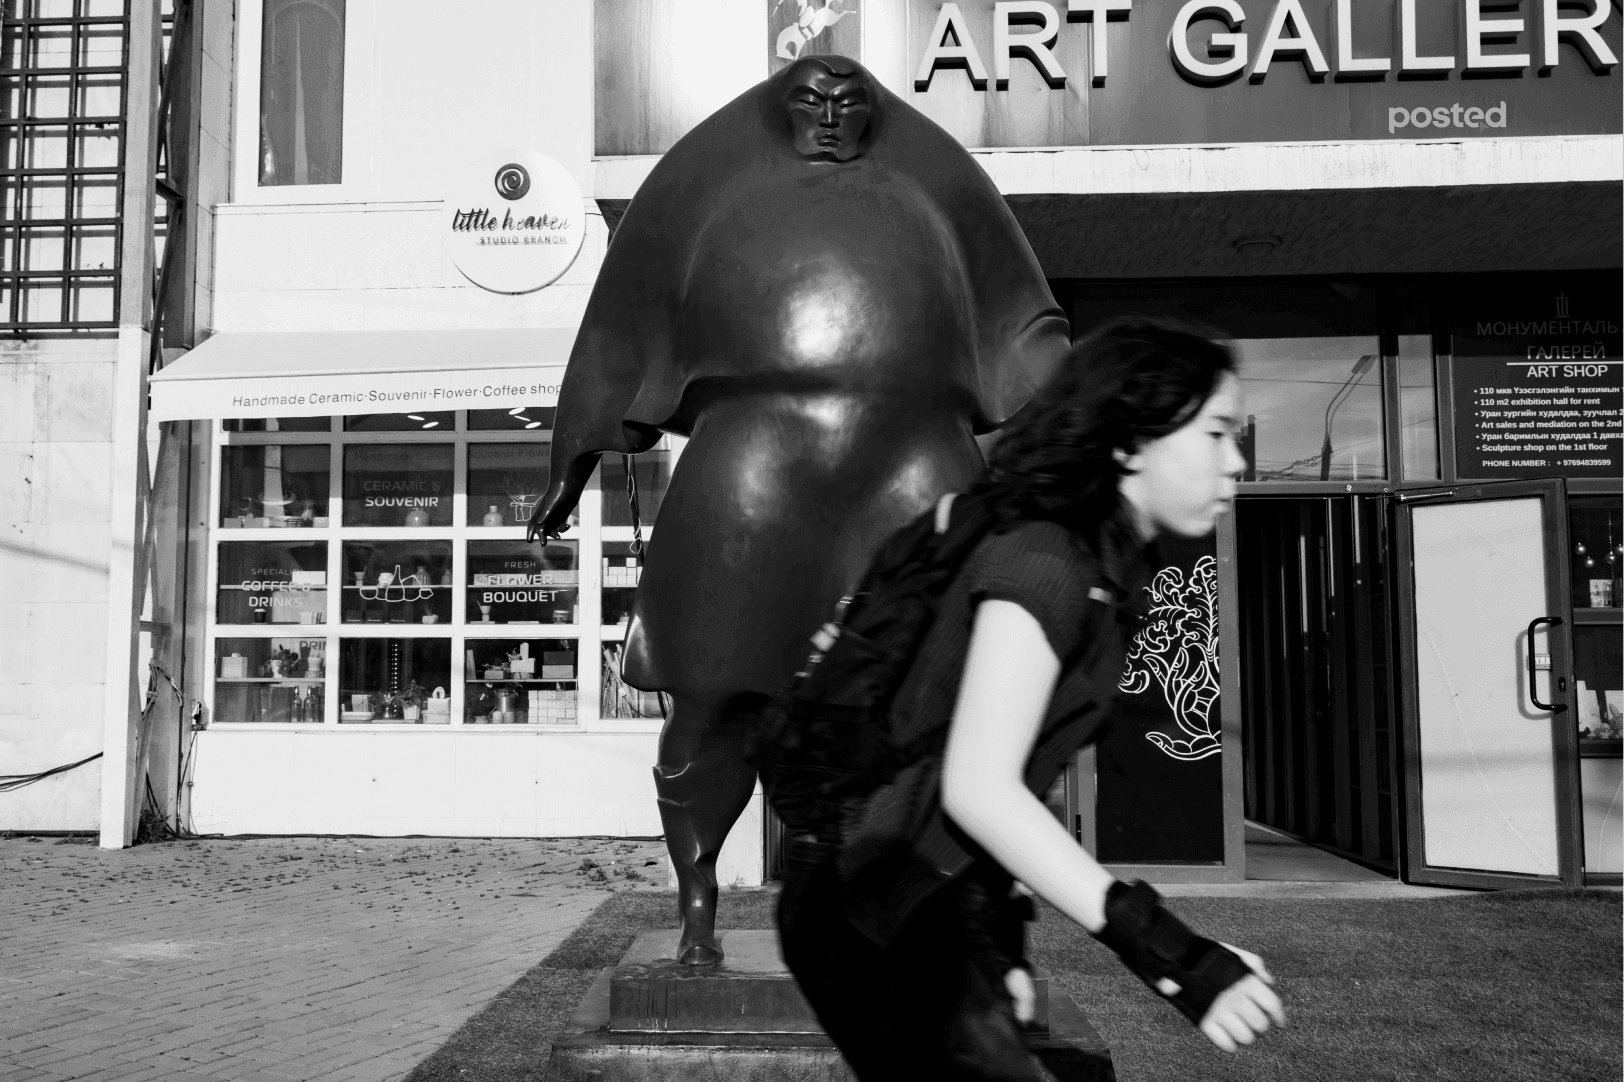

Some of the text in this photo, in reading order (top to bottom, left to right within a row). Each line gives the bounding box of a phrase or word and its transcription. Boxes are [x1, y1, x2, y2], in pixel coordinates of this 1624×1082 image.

[914, 0, 1622, 92] ART GALLER
[452, 206, 572, 232] little heaven
[480, 235, 567, 245] STUDIO BRANCH
[1477, 320, 1618, 336] МОНУМЕНТАЛЬ
[1527, 341, 1606, 360] ГАЛЕРЕЙ
[1526, 365, 1608, 378] ART SHOP
[1480, 387, 1494, 395] 110
[232, 394, 306, 407] Handmade
[1480, 397, 1601, 406] 110 m2 exhibition hall for rent
[1480, 410, 1501, 419] Уран
[1503, 409, 1537, 419] зургийн
[1538, 410, 1581, 418] худалдаа,
[1481, 421, 1494, 429] Art
[1496, 421, 1517, 429] sales
[1519, 420, 1535, 428] and
[1536, 420, 1577, 428] mediation
[1591, 420, 1605, 428] the
[1606, 420, 1622, 428] 2nd
[1481, 432, 1503, 441] Уран
[1504, 432, 1549, 441] баримлын
[1550, 433, 1591, 441] худалдаа
[1593, 431, 1599, 439] 1
[1481, 443, 1522, 453] Sculpture
[1523, 443, 1545, 453] shop
[1558, 443, 1572, 451] the
[1573, 443, 1587, 451] 1st
[1588, 443, 1608, 451] floor
[1511, 459, 1547, 467] NUMBER
[363, 480, 427, 492] CERAMIC
[365, 496, 439, 507] SOUVENIR
[504, 561, 536, 569] FRESH
[241, 580, 297, 592] COFFEE
[487, 574, 553, 586] FLOWER
[248, 596, 304, 608] DRINKS
[483, 590, 559, 603] BOUQUET
